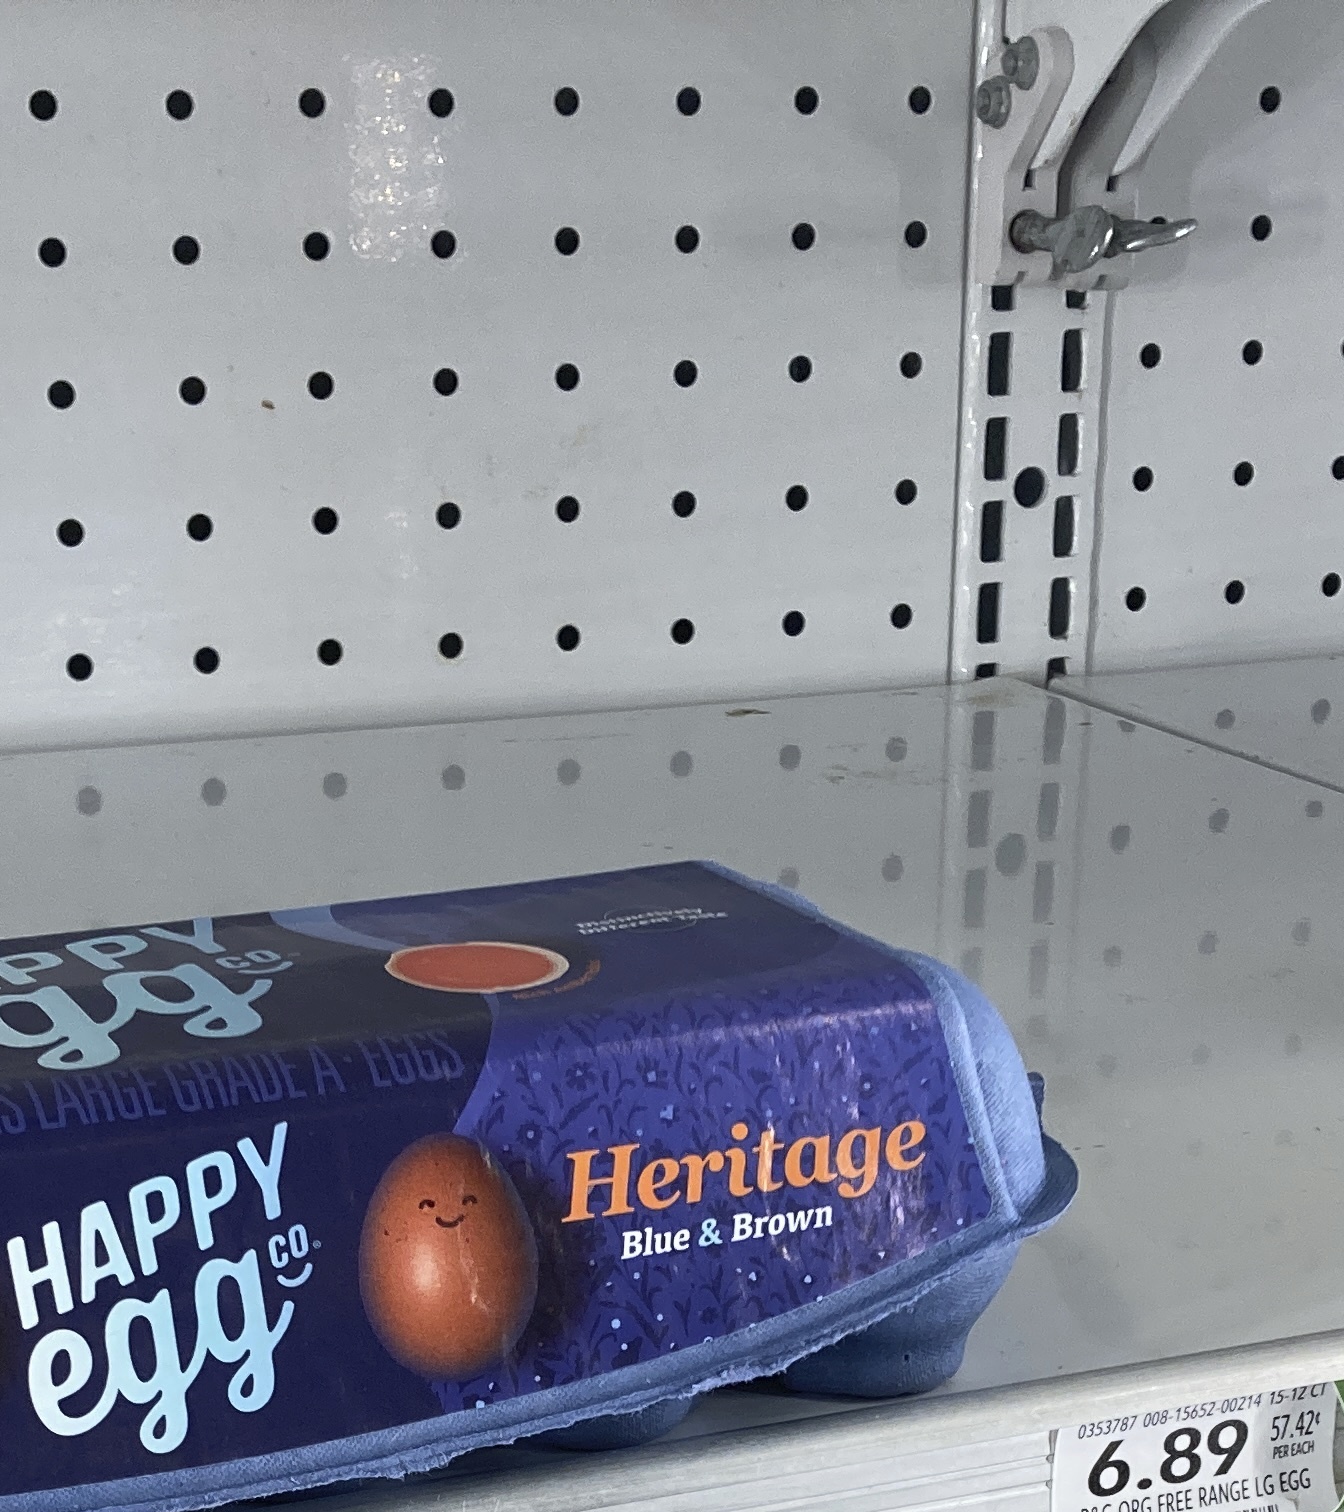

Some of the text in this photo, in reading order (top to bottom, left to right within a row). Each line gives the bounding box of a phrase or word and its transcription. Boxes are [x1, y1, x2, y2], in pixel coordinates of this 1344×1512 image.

[24, 1068, 168, 1128] LARGE
[163, 1048, 309, 1115] GRADE
[560, 1117, 928, 1224] Heritage
[6, 1121, 288, 1330] HAPPY
[620, 1205, 834, 1261] Blue & Brown
[28, 1247, 295, 1454] egg
[1077, 1415, 1137, 1440] 0353787
[1087, 1418, 1249, 1498] 6.89
[1270, 1409, 1321, 1442] 57.42¢
[1292, 1440, 1315, 1459] EACH
[1198, 1481, 1250, 1510] RANGE
[1255, 1477, 1275, 1498] LG
[1279, 1468, 1312, 1493] EGG
